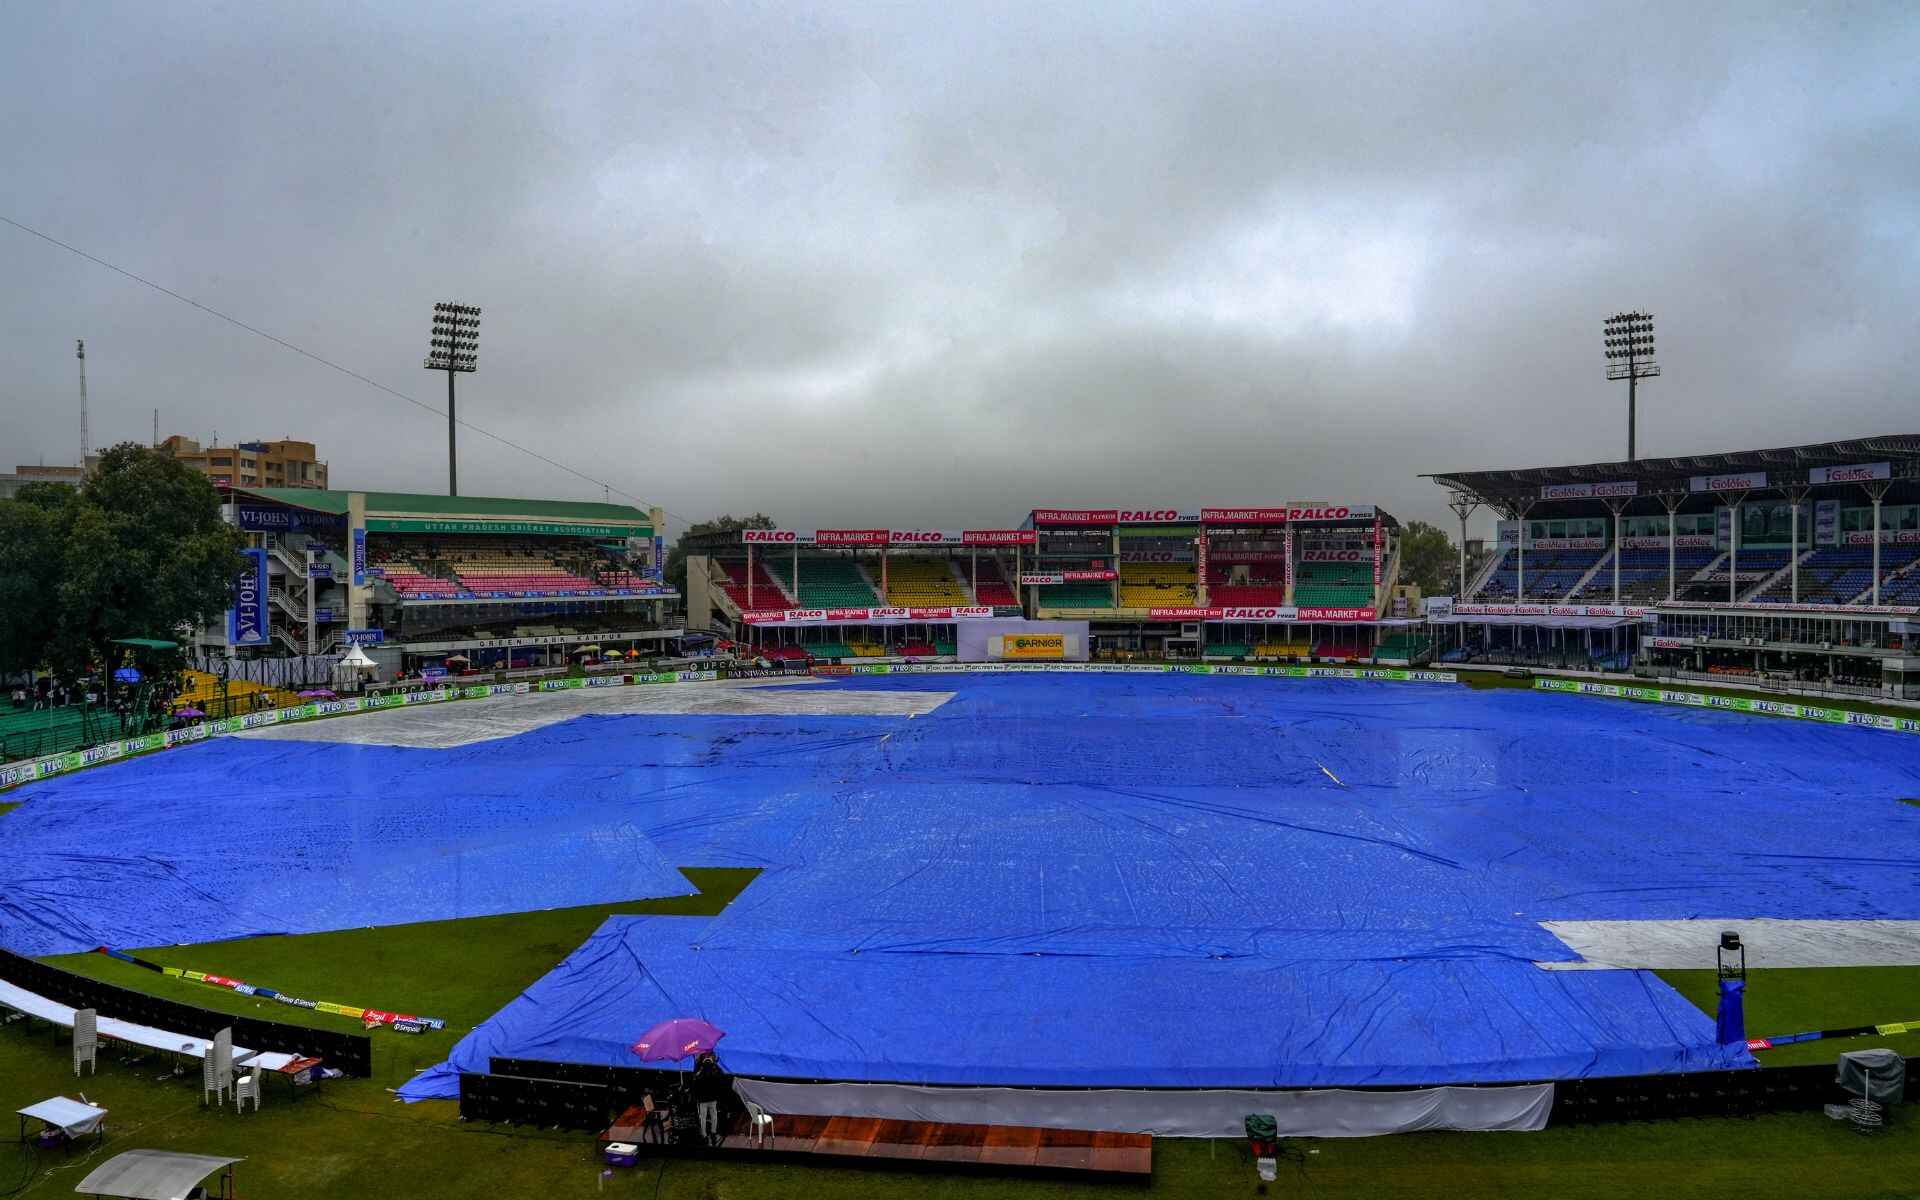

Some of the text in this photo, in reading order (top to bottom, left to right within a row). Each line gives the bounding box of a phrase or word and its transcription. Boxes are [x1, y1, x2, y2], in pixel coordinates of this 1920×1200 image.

[241, 511, 289, 523] VI-JOHN
[1037, 512, 1090, 520] INFRA.MARKET
[1120, 510, 1177, 521] RALCO
[1203, 511, 1258, 519] INFRA.MARKET
[1289, 507, 1349, 520] RALCO
[425, 523, 611, 534] UTTAR PRADESH CRICKET ASSOCIATION
[745, 531, 796, 541] RALCO
[818, 532, 873, 541] INFRA.MARKET
[892, 532, 942, 541] RALCO
[964, 532, 1019, 542] INFRA.MARKET
[1120, 552, 1173, 561] RALCO
[1304, 551, 1360, 560] RALCO
[789, 610, 823, 618] RALCO
[1225, 608, 1276, 618] RALCO
[1300, 610, 1358, 618] INFRA.MARKET
[480, 633, 622, 647] GREEN PARK KANPUR
